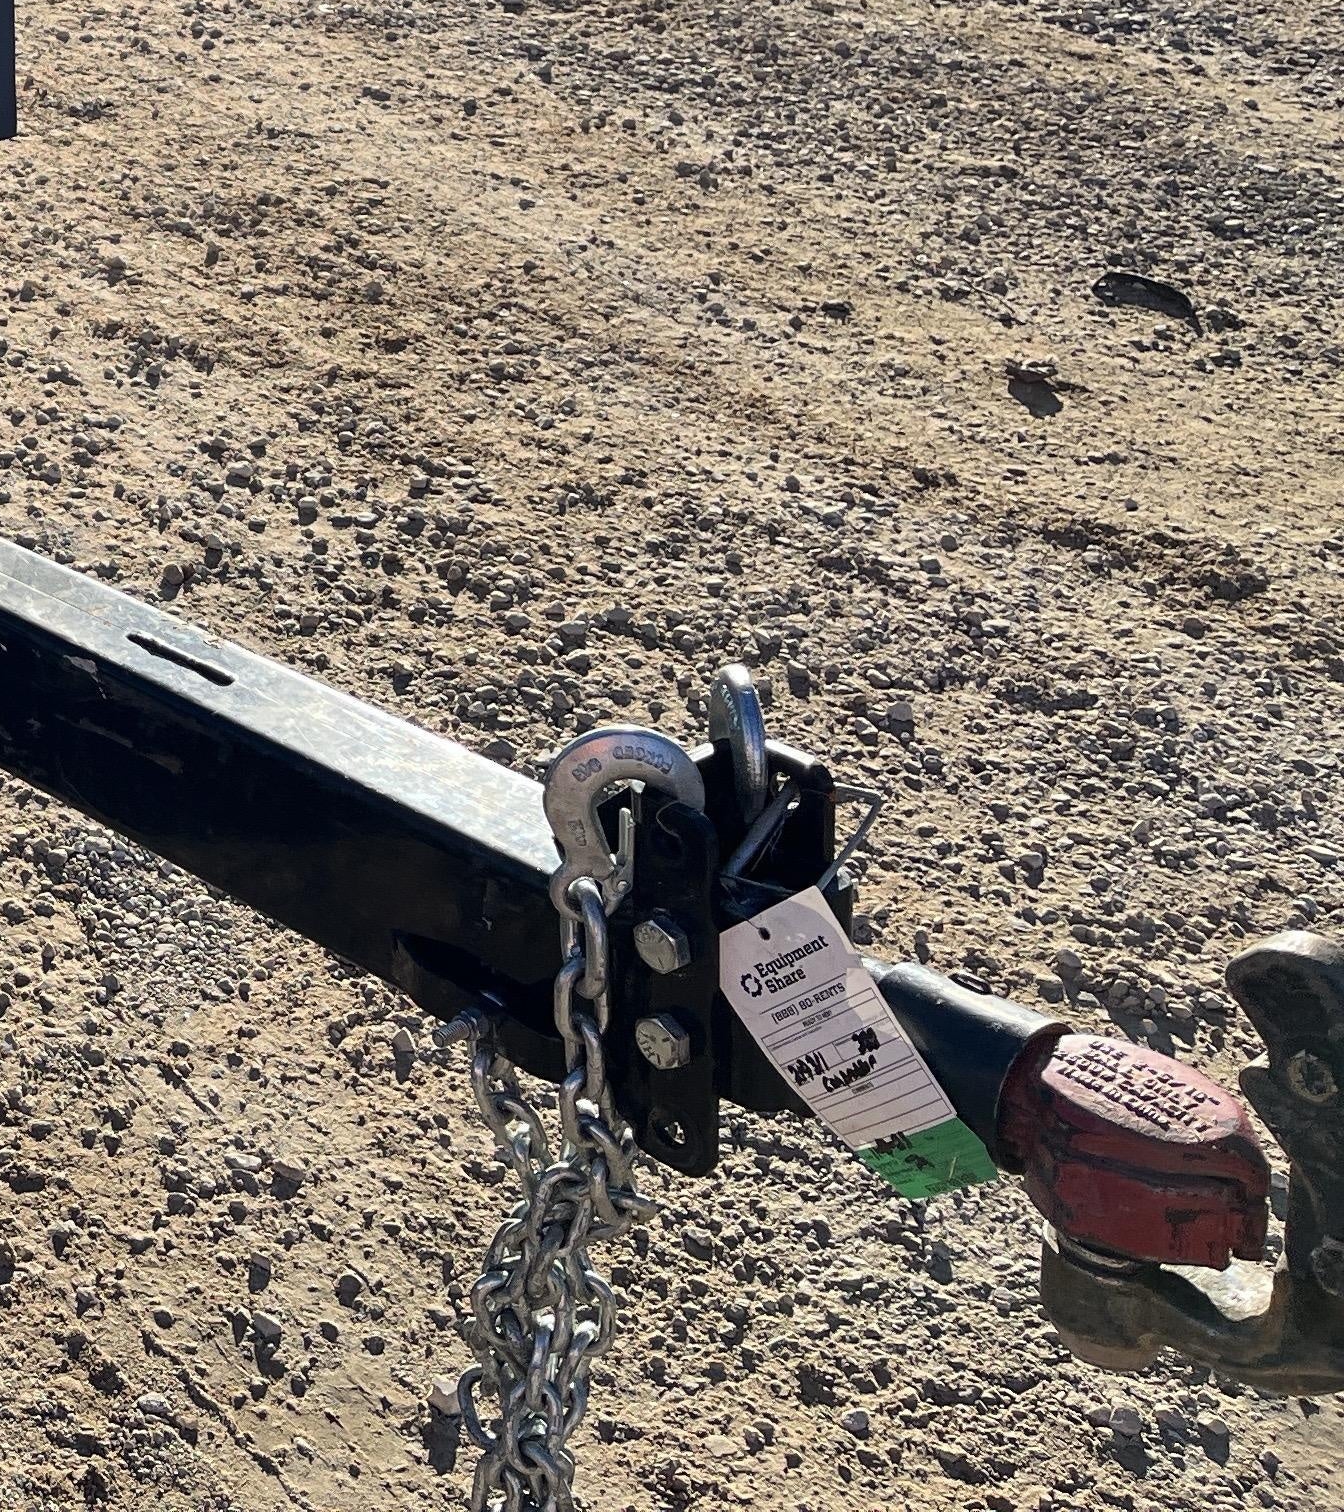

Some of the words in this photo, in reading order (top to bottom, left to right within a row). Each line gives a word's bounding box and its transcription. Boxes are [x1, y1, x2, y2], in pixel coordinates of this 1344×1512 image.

[753, 935, 829, 978] Equipment
[764, 967, 807, 994] Share
[798, 982, 846, 1010] 80-RENTS
